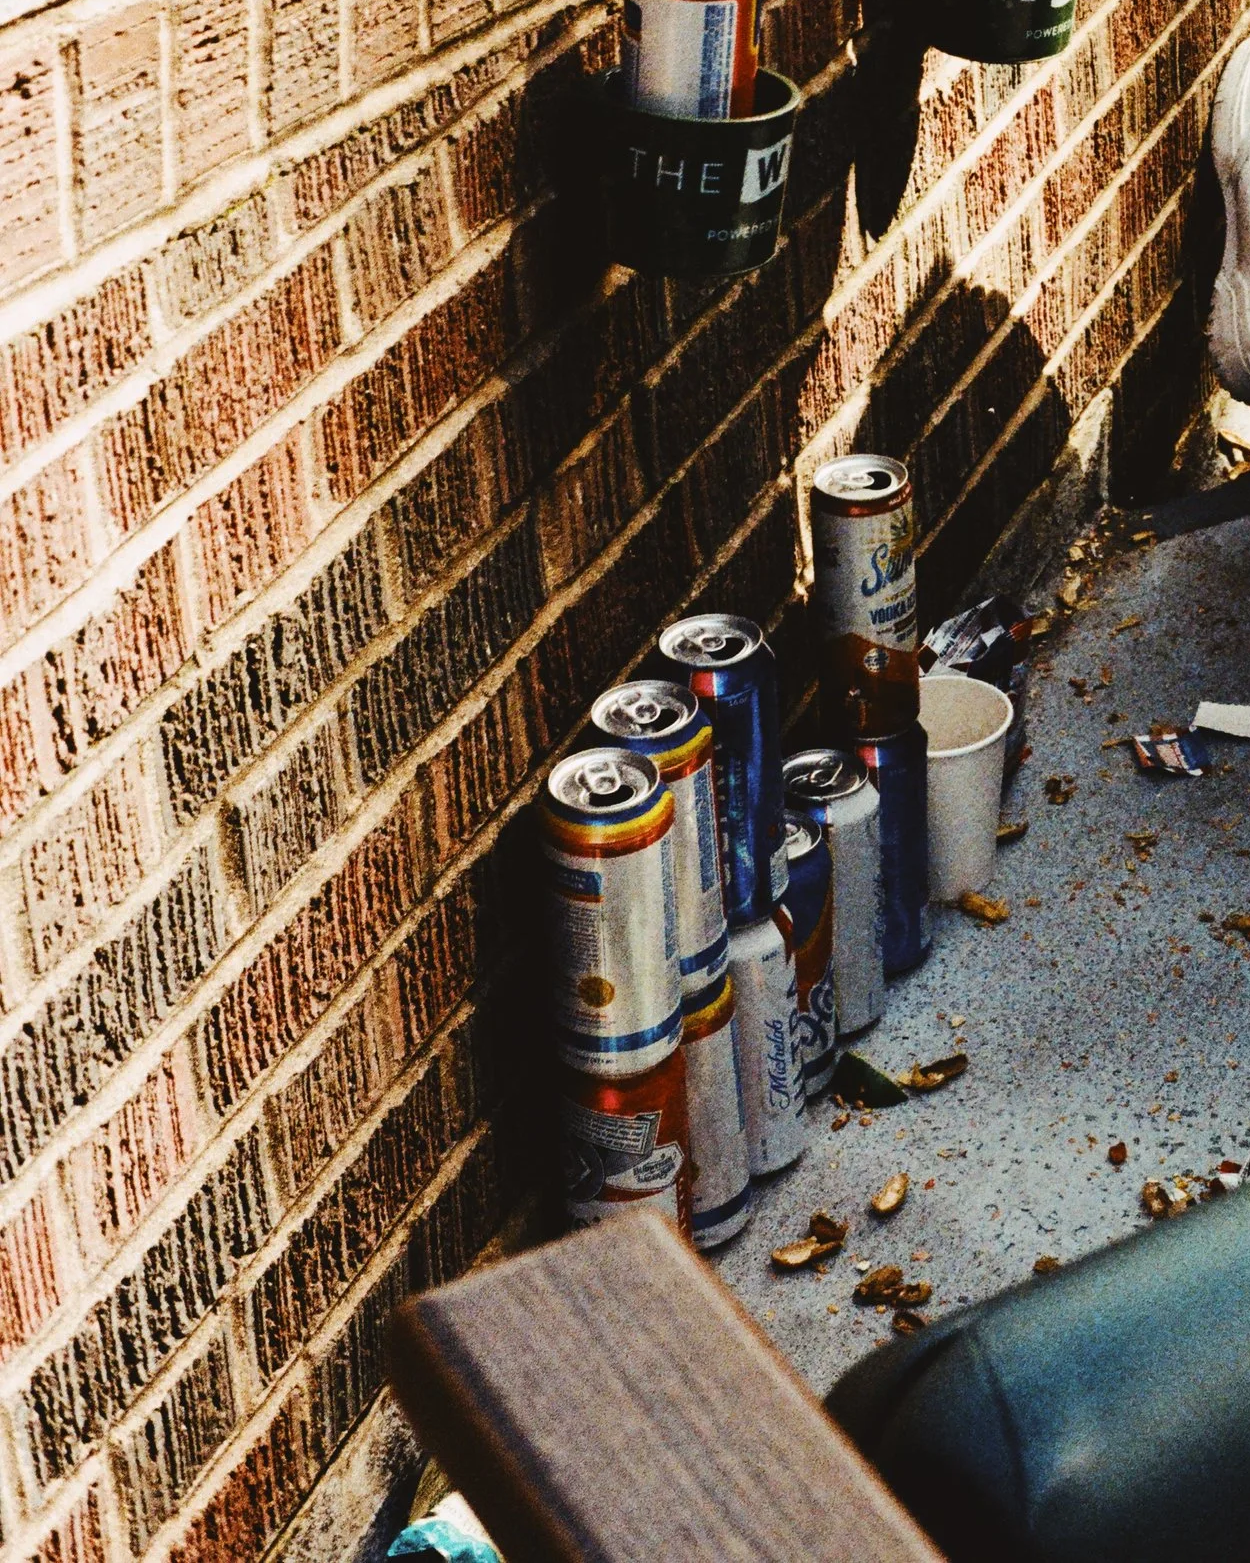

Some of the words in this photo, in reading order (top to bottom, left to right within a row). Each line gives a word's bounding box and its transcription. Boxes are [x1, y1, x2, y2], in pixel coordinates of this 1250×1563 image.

[628, 146, 724, 195] THE
[757, 142, 789, 192] W
[870, 600, 906, 626] VODKA
[764, 1017, 791, 1110] Michelob
